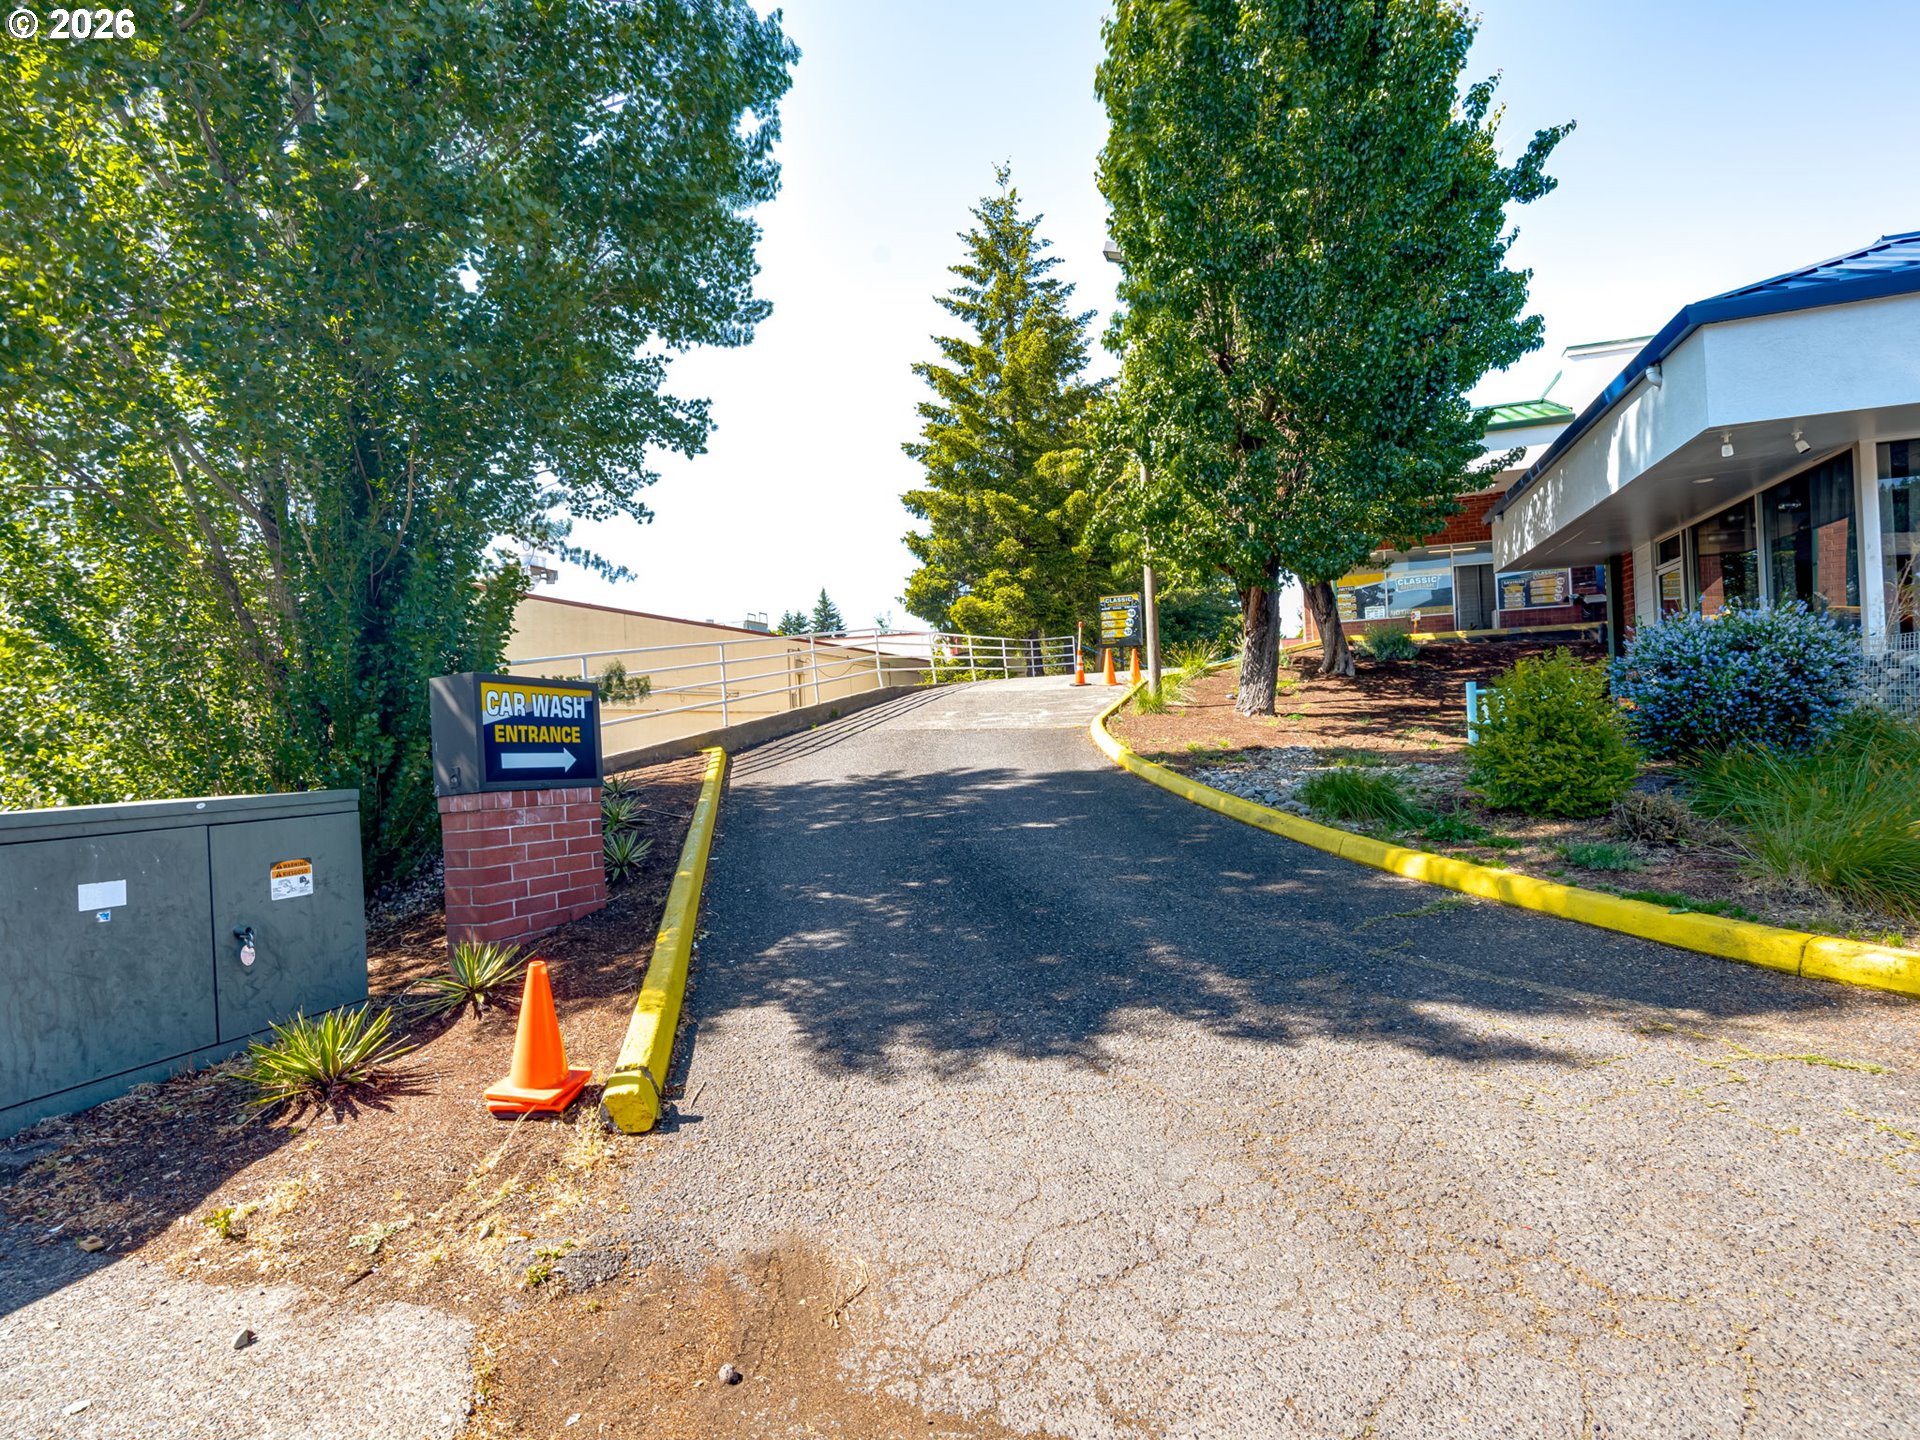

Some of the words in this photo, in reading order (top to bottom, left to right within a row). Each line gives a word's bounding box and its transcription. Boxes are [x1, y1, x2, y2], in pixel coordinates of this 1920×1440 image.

[1397, 576, 1437, 586] CLASSIC
[1105, 596, 1132, 604] CLASSIC
[485, 690, 526, 717] CAR
[532, 693, 586, 719] WASH
[494, 724, 581, 744] ENTRANCE
